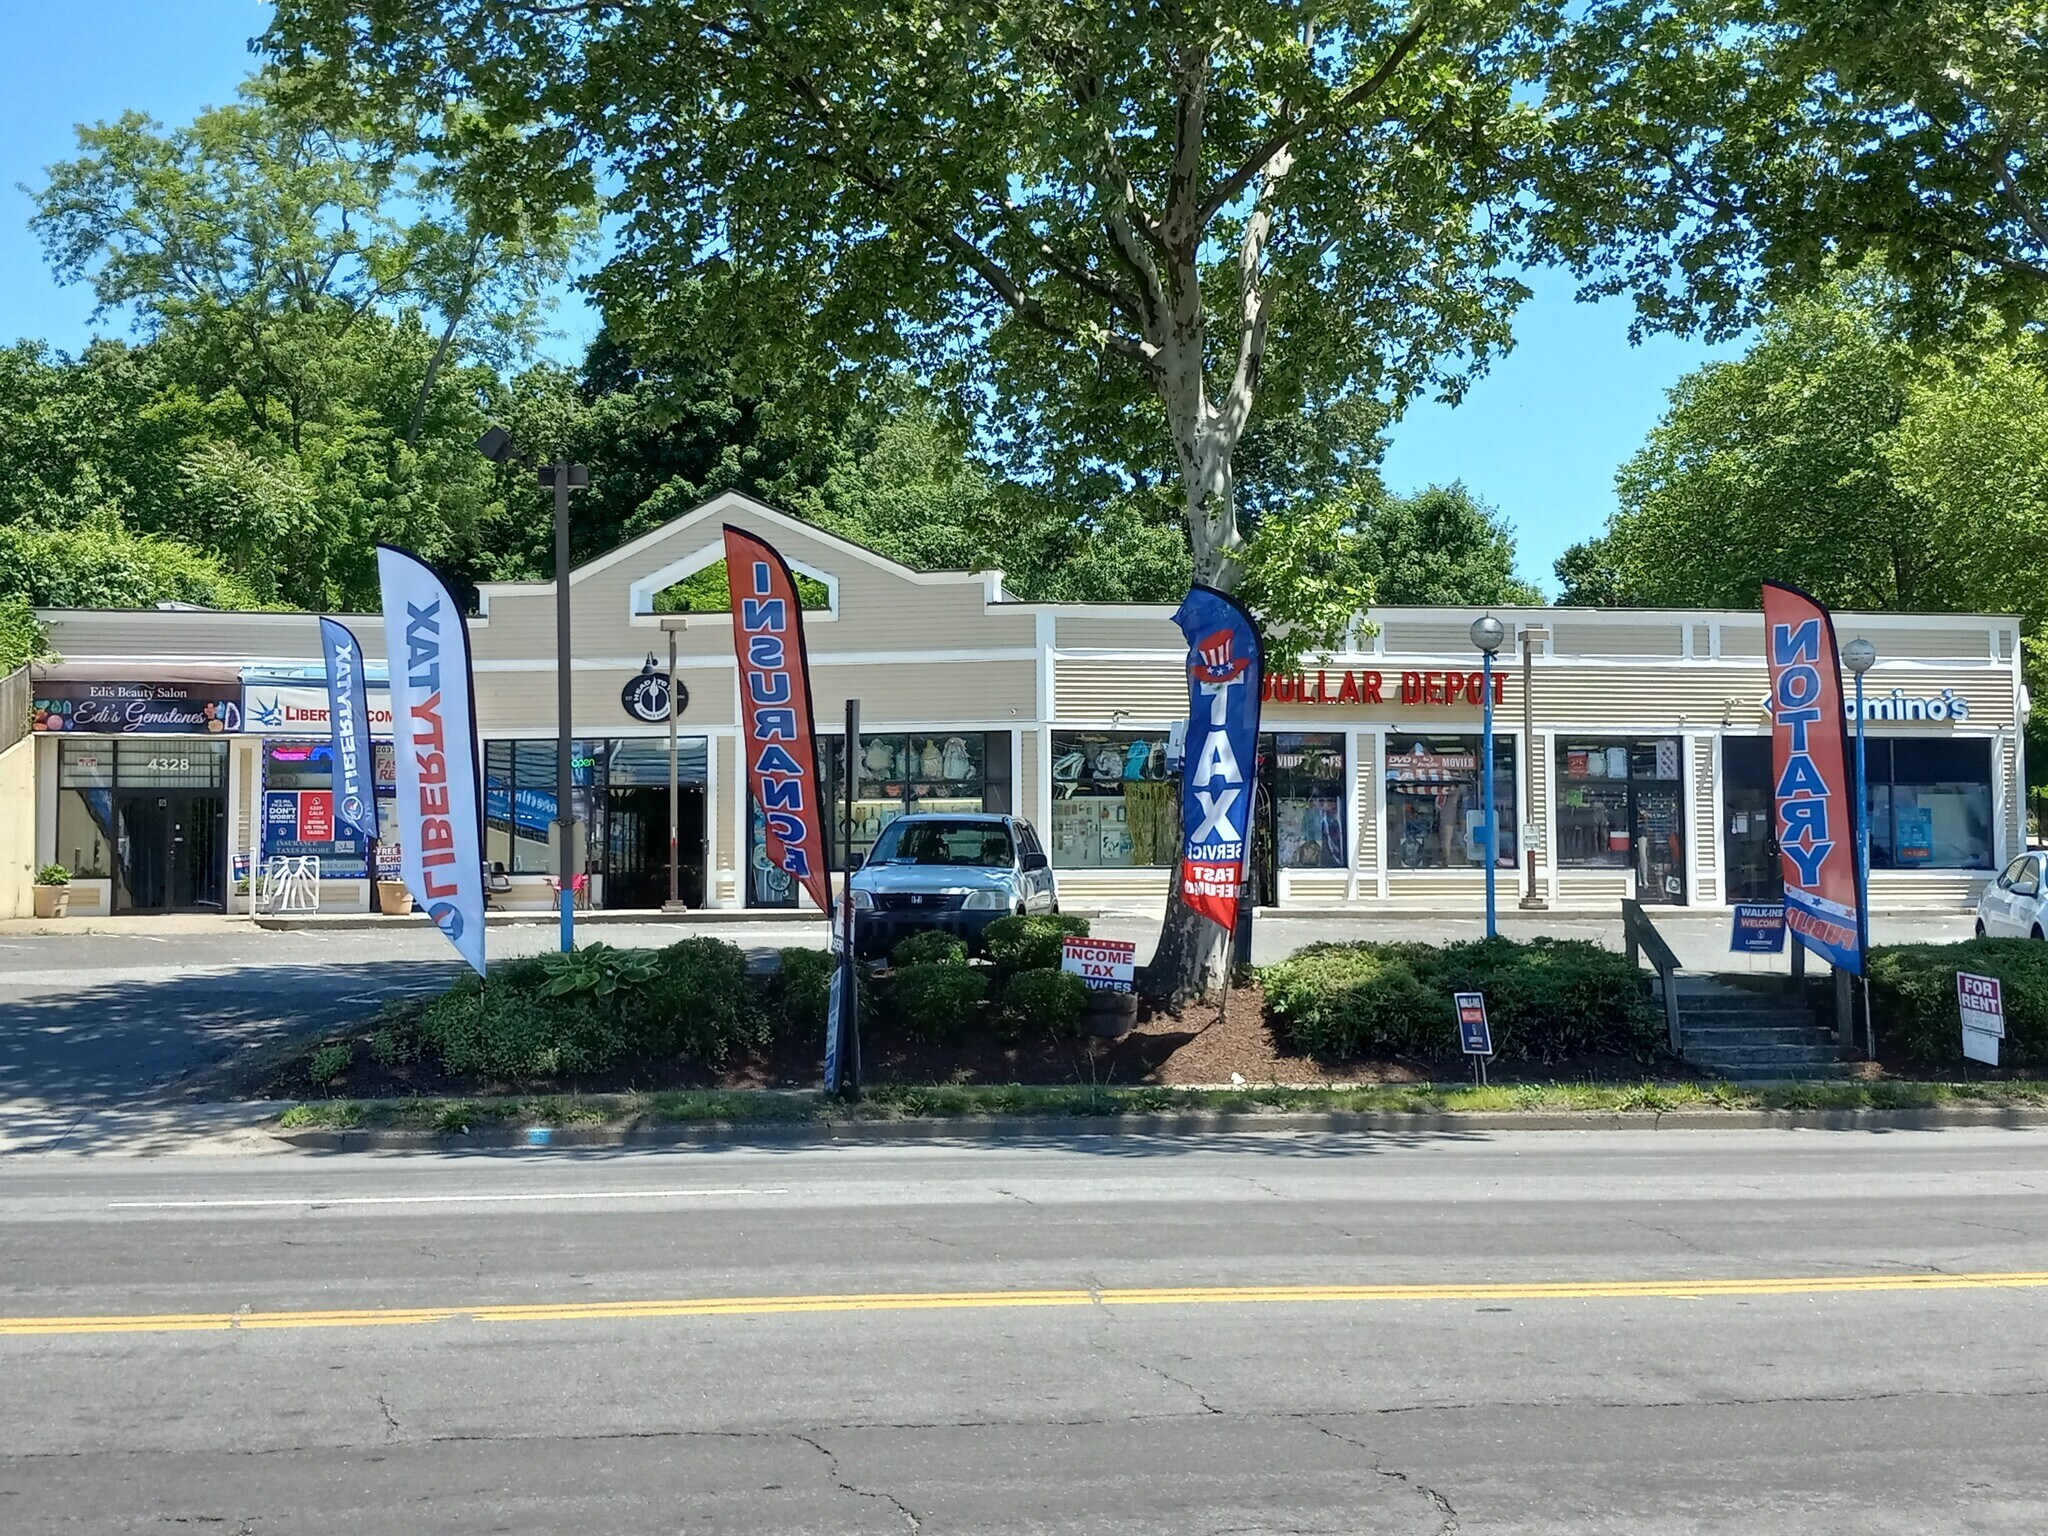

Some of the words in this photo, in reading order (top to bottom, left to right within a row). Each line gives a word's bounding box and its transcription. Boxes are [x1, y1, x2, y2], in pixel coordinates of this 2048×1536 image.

[90, 686, 115, 698] Edi's
[118, 686, 154, 700] Beauty
[157, 687, 187, 698] Salon
[633, 679, 651, 701] HEAD
[657, 678, 667, 687] TO
[1402, 671, 1508, 705] DEPOT
[285, 705, 332, 721] LIBERT
[1844, 688, 1970, 721] omino's
[73, 701, 121, 724] Edi's
[123, 701, 206, 732] Gemstones
[147, 758, 190, 771] 4328
[571, 758, 595, 768] open
[1442, 757, 1474, 768] MOVIES
[1741, 908, 1784, 917] WALK-INS
[1065, 947, 1133, 965] INCOME
[1081, 963, 1115, 978] TAX
[1963, 978, 1993, 997] FOR
[1961, 993, 1998, 1013] RENT
